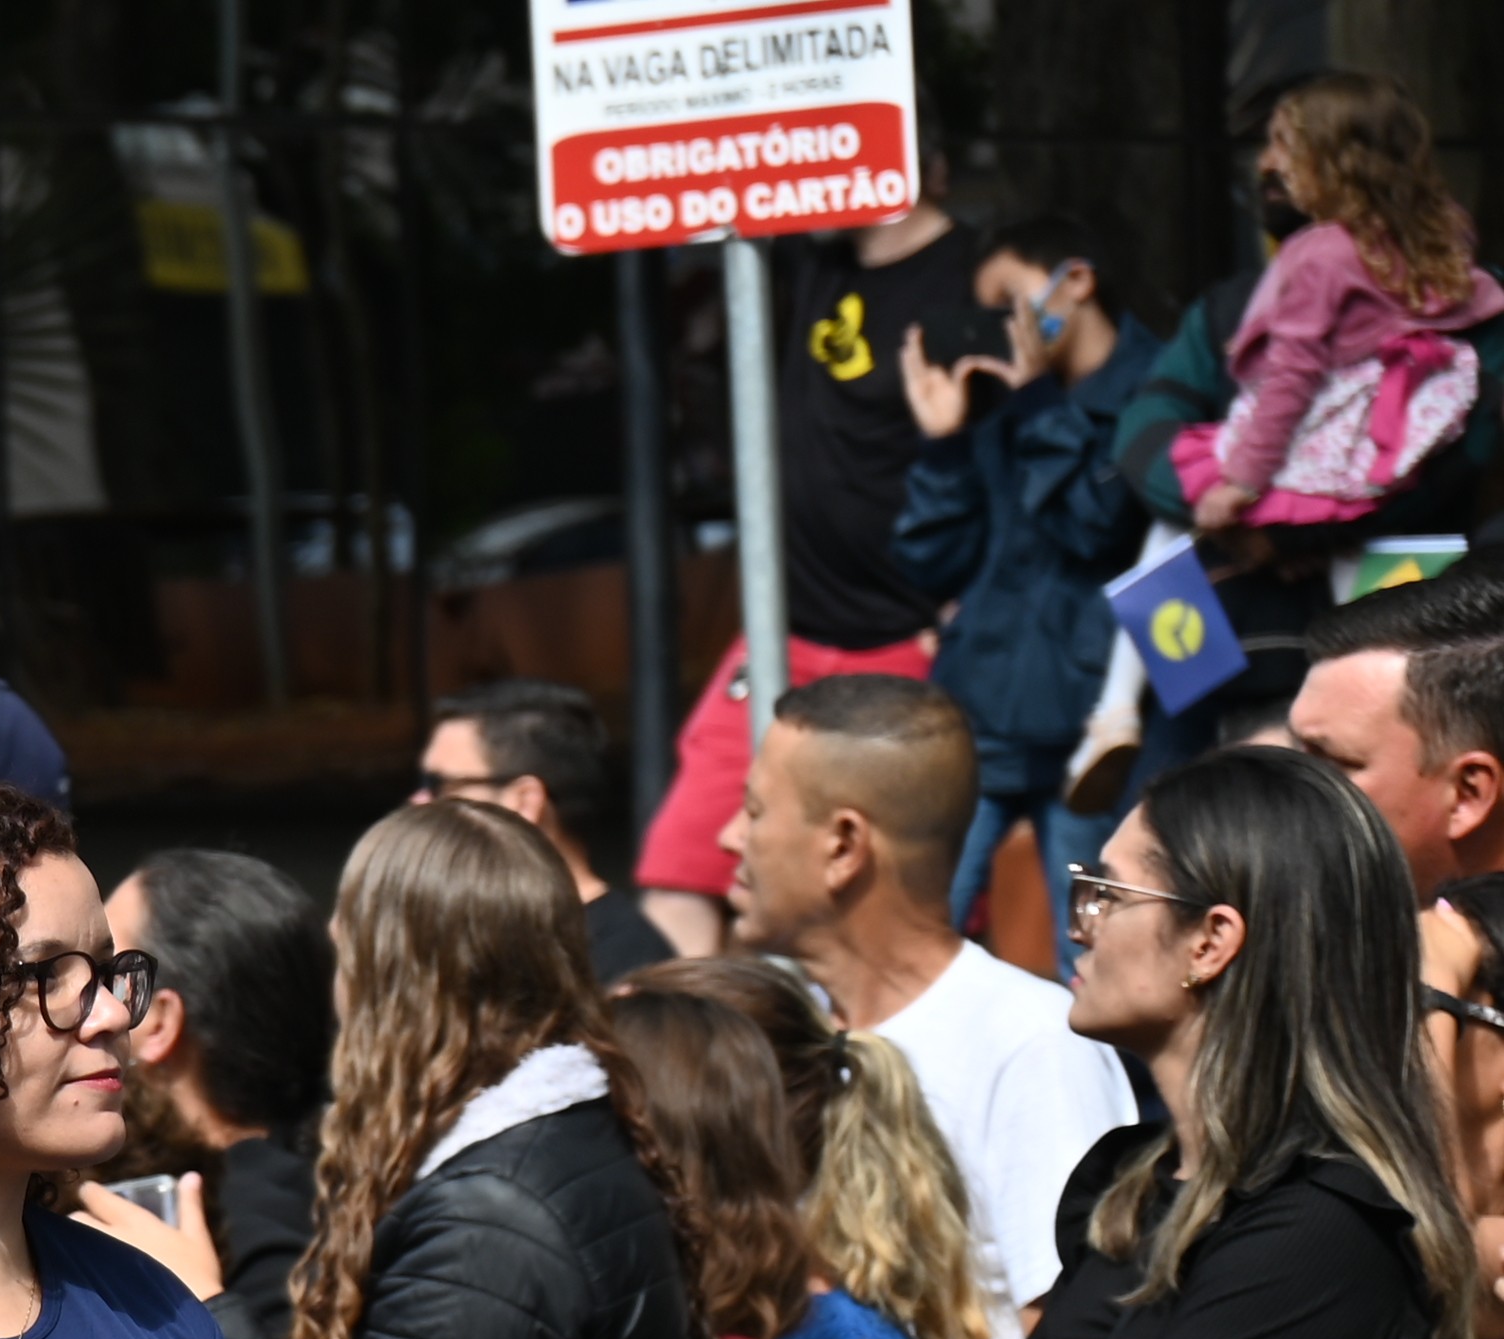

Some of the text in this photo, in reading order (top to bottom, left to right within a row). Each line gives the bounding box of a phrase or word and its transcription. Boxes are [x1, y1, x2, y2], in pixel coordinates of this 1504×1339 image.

[552, 23, 891, 95] NA VAGA DELIMITADA
[593, 123, 862, 186] OBRIGATÓRIO
[555, 165, 907, 241] O USO DO CARTÃO
